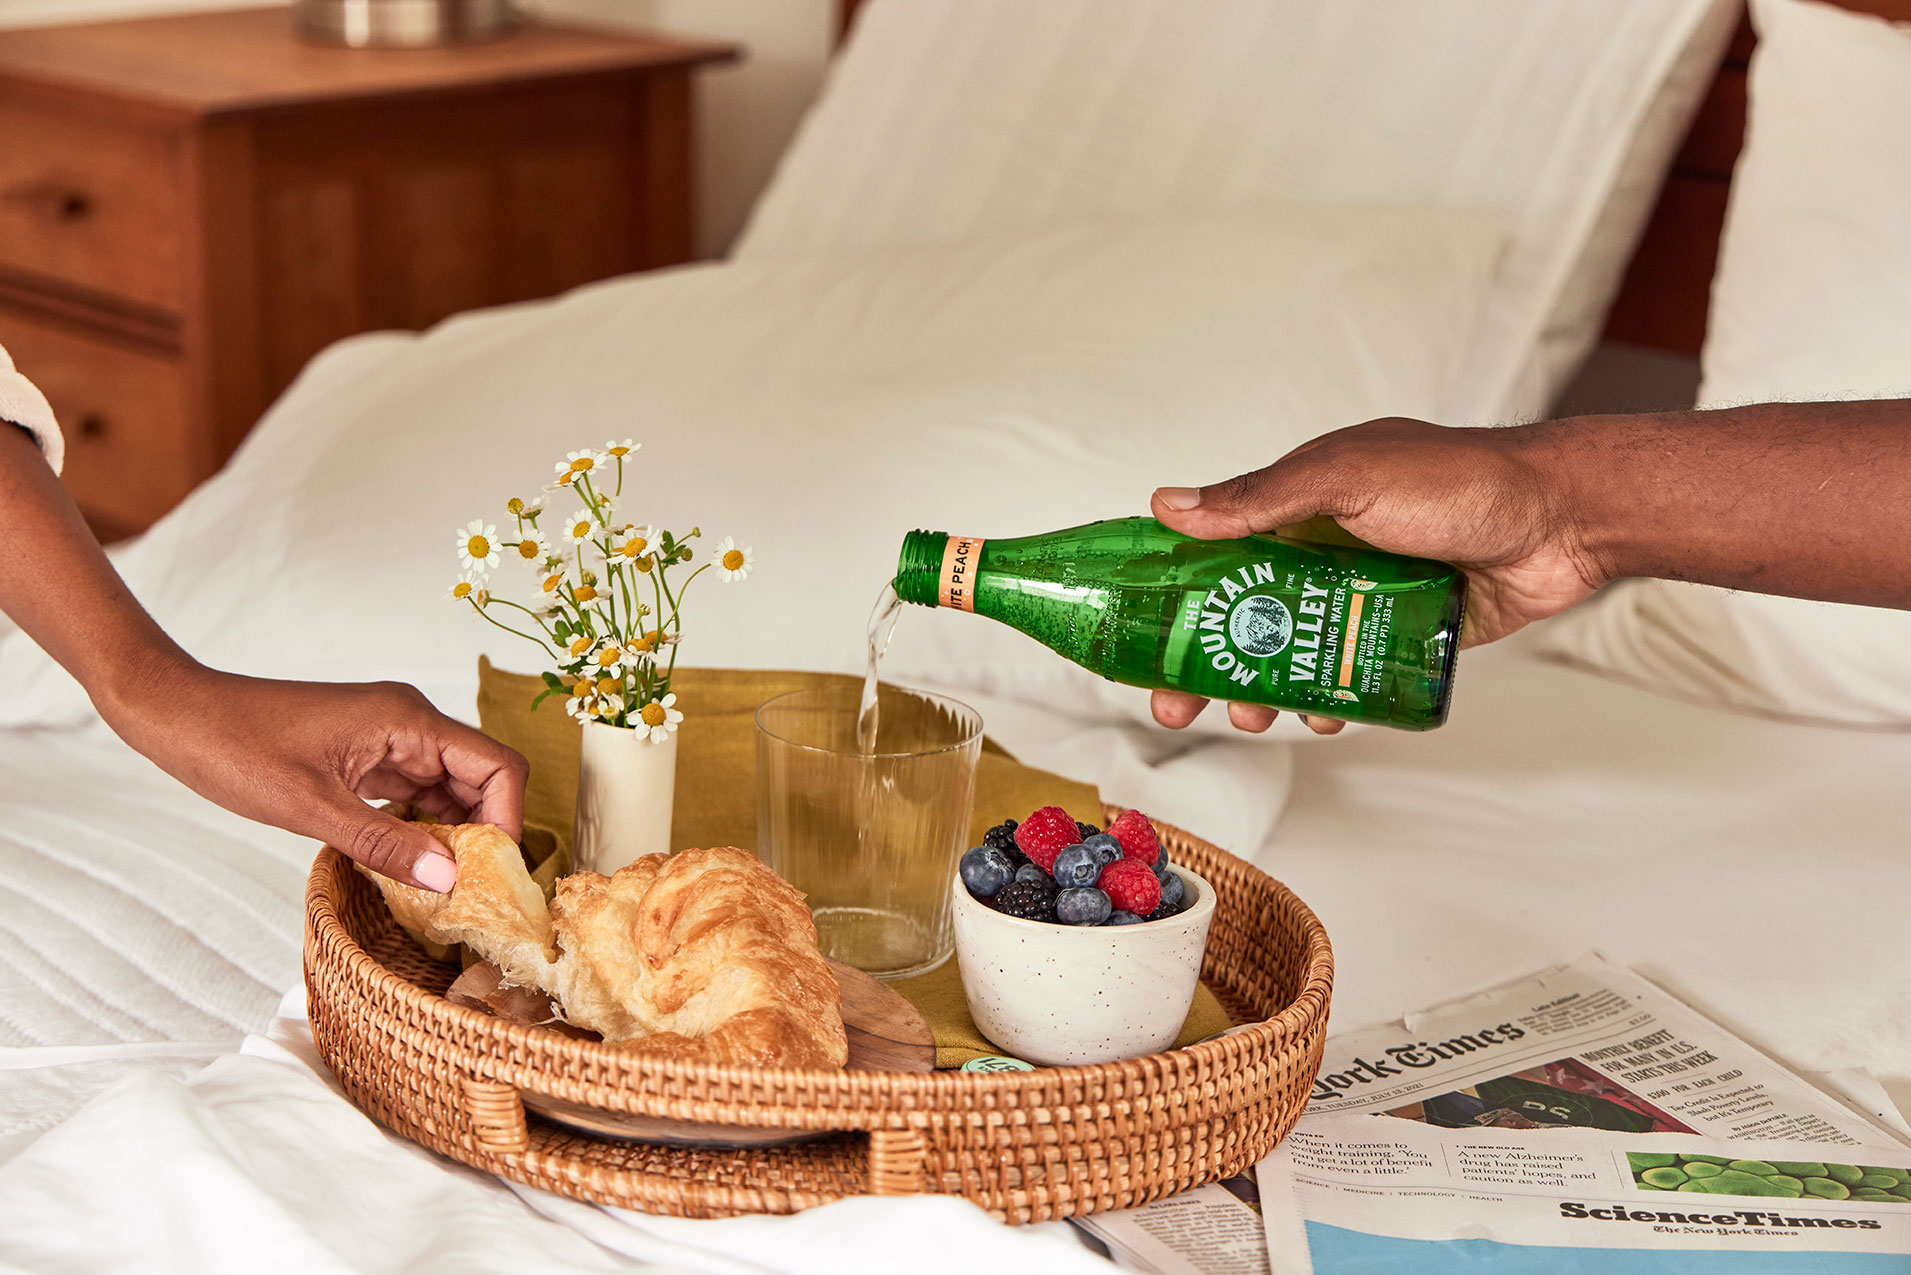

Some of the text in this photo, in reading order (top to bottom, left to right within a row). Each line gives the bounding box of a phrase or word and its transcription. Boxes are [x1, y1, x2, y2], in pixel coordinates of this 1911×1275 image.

[952, 542, 971, 584] PEACH
[1285, 573, 1295, 589] FINE
[1183, 600, 1200, 631] THE
[1199, 562, 1276, 687] MOUNTAIN
[1233, 608, 1246, 638] AUTHENTIC
[1320, 587, 1346, 687] SPARKLING WATER
[1343, 615, 1359, 665] WHITE PEACH
[1357, 641, 1367, 666] BOTTLED
[1362, 620, 1371, 634] THE
[1371, 597, 1395, 694] 11.3 FL OZ (0.7 PT) 333 mL
[1271, 669, 1280, 686] PURE
[1385, 1022, 1526, 1068] Times
[1579, 1028, 1675, 1062] MONTHLY BENEFIT
[1600, 1040, 1698, 1072] FOR MANY IN U.S.
[1621, 1050, 1719, 1083] STARTS THIS WEEK
[1671, 1084, 1692, 1093] FOR
[1692, 1078, 1716, 1089] EACH
[1716, 1069, 1743, 1082] CHILD
[1326, 1098, 1370, 1110] TUESDAY,
[1371, 1092, 1391, 1101] JULY
[1405, 1082, 1424, 1092] 2021
[1667, 1104, 1686, 1112] Tax
[1684, 1096, 1711, 1108] Credit
[1717, 1086, 1754, 1100] Expected
[1687, 1107, 1712, 1117] Slash
[1710, 1099, 1741, 1112] Poverty
[1702, 1114, 1721, 1122] but
[1731, 1099, 1774, 1115] Temporary
[1288, 1136, 1330, 1148] When
[1290, 1144, 1334, 1156] weight
[1338, 1149, 1395, 1158] training,
[1291, 1151, 1314, 1161] can
[1370, 1158, 1385, 1166] of
[1387, 1158, 1433, 1167] benefit
[1292, 1157, 1324, 1169] from
[1328, 1166, 1359, 1174] even
[1459, 1159, 1563, 1170] drug has raised
[1505, 1152, 1584, 1162] Alzheimer's
[1463, 1175, 1513, 1183] caution
[1537, 1179, 1568, 1187] well.
[1522, 1169, 1567, 1179] hopes,
[1570, 1172, 1596, 1180] and
[1295, 1178, 1330, 1188] SCIENCE
[1343, 1187, 1385, 1196] MEDICINE
[1653, 1225, 1799, 1237] The New York Times
